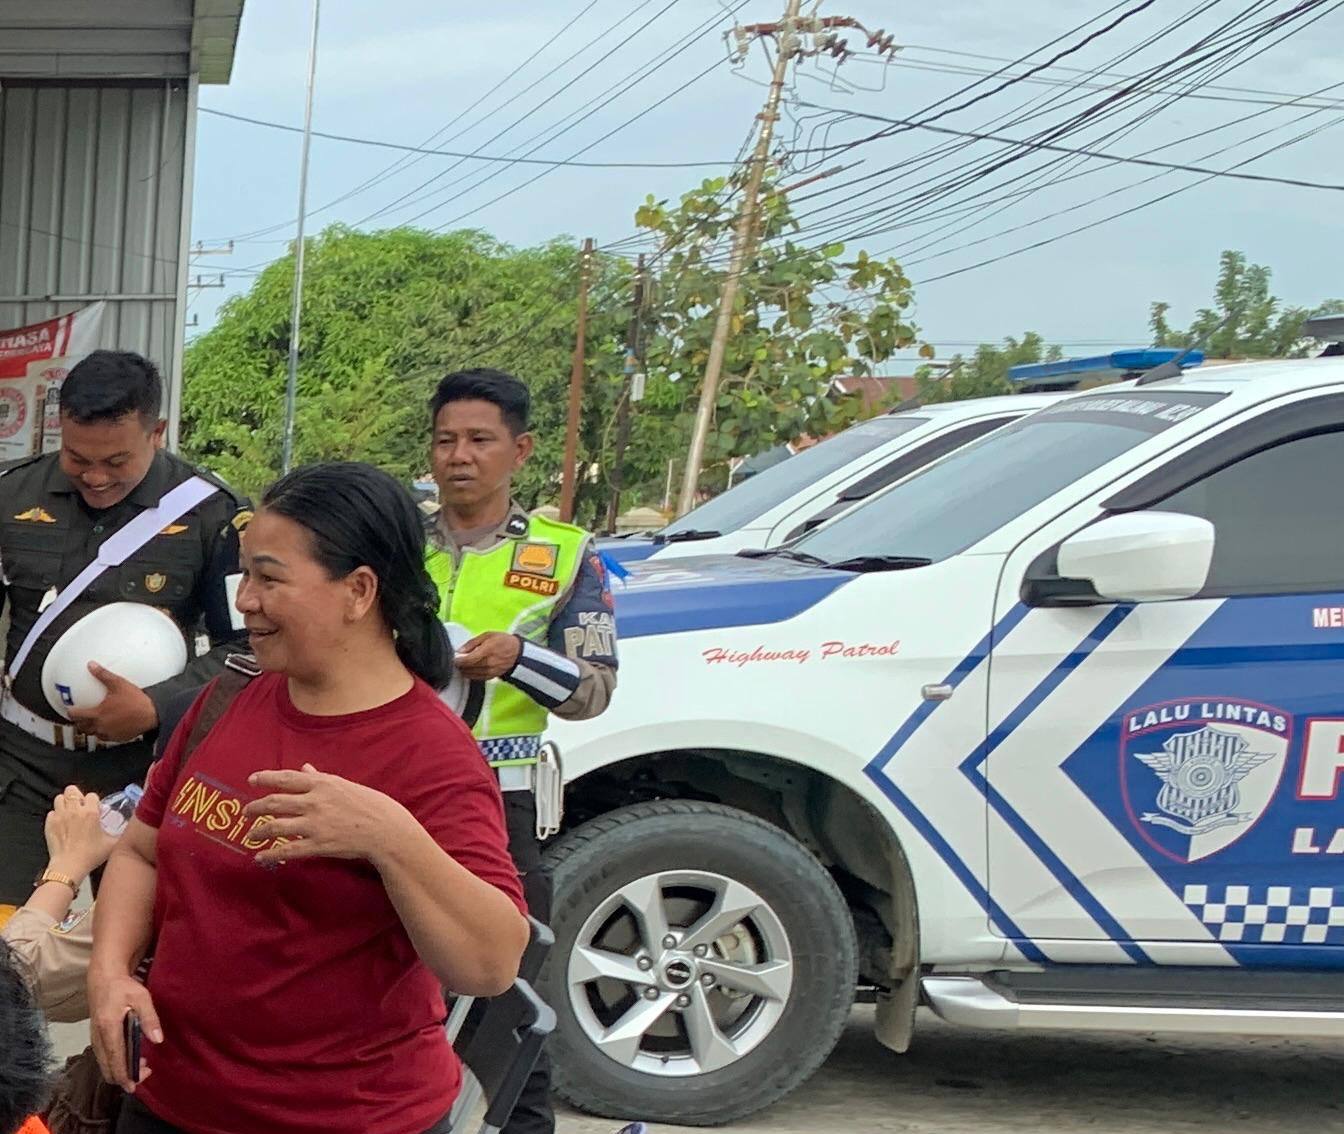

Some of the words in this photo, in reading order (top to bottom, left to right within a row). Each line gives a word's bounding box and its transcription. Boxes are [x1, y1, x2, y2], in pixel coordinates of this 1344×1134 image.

[510, 574, 554, 593] POLRI
[1313, 607, 1344, 628] ME
[702, 645, 811, 667] Highway
[820, 640, 901, 660] Patrol
[1129, 704, 1190, 732] LALU
[1201, 702, 1287, 732] LINTAS
